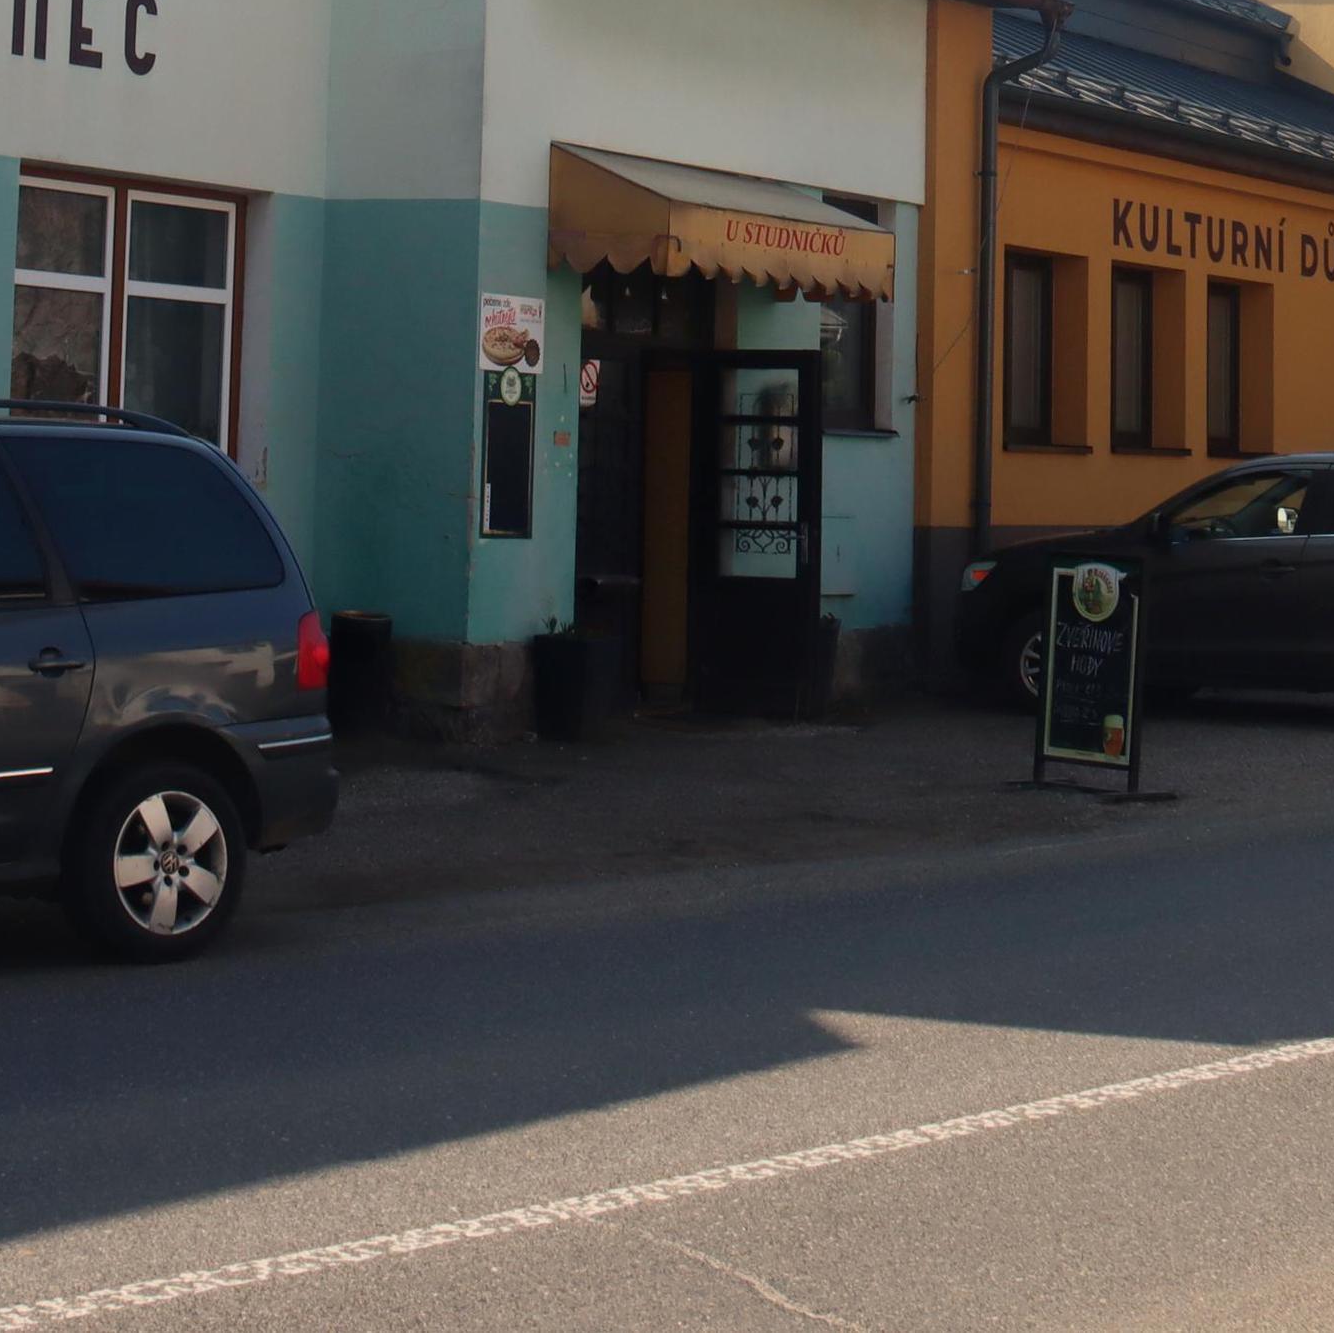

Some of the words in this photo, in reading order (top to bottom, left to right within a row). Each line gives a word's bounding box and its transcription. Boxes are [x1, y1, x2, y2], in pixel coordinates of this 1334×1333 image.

[727, 219, 739, 242] U
[744, 221, 846, 256] STUDNIČKŮ
[1112, 198, 1286, 273] KULTURNÍ
